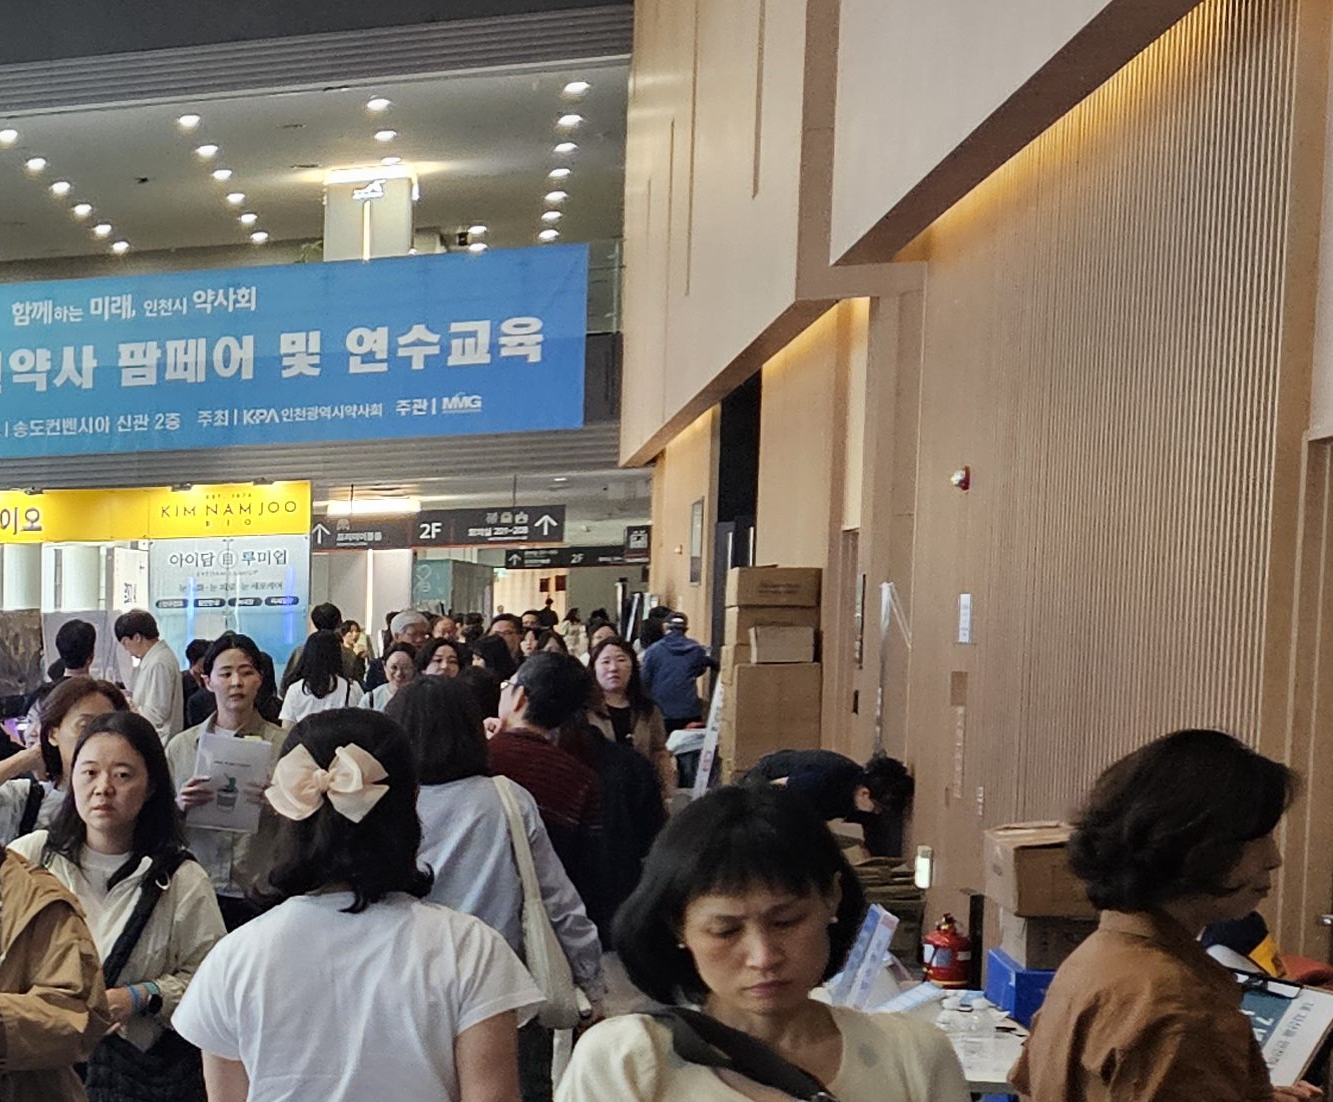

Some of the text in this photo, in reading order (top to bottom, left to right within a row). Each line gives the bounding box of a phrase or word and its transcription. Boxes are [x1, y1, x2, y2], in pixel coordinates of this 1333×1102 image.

[12, 286, 257, 327] 함께하는 미래, 인천시 약사회
[118, 334, 255, 388] 팜페어
[280, 330, 322, 378] 및
[345, 316, 545, 373] 연수교육
[13, 418, 110, 438] 송도컨벤시아
[116, 414, 150, 433] 신관
[154, 412, 181, 431] 2층
[197, 409, 229, 428] 주최
[281, 402, 383, 424] 인천광역시약사회
[396, 398, 428, 417] 주관
[161, 501, 297, 518] KIM NAM JOO
[205, 518, 252, 527] BIO
[419, 522, 443, 540] 2F
[169, 550, 288, 568] 아이담 루미업
